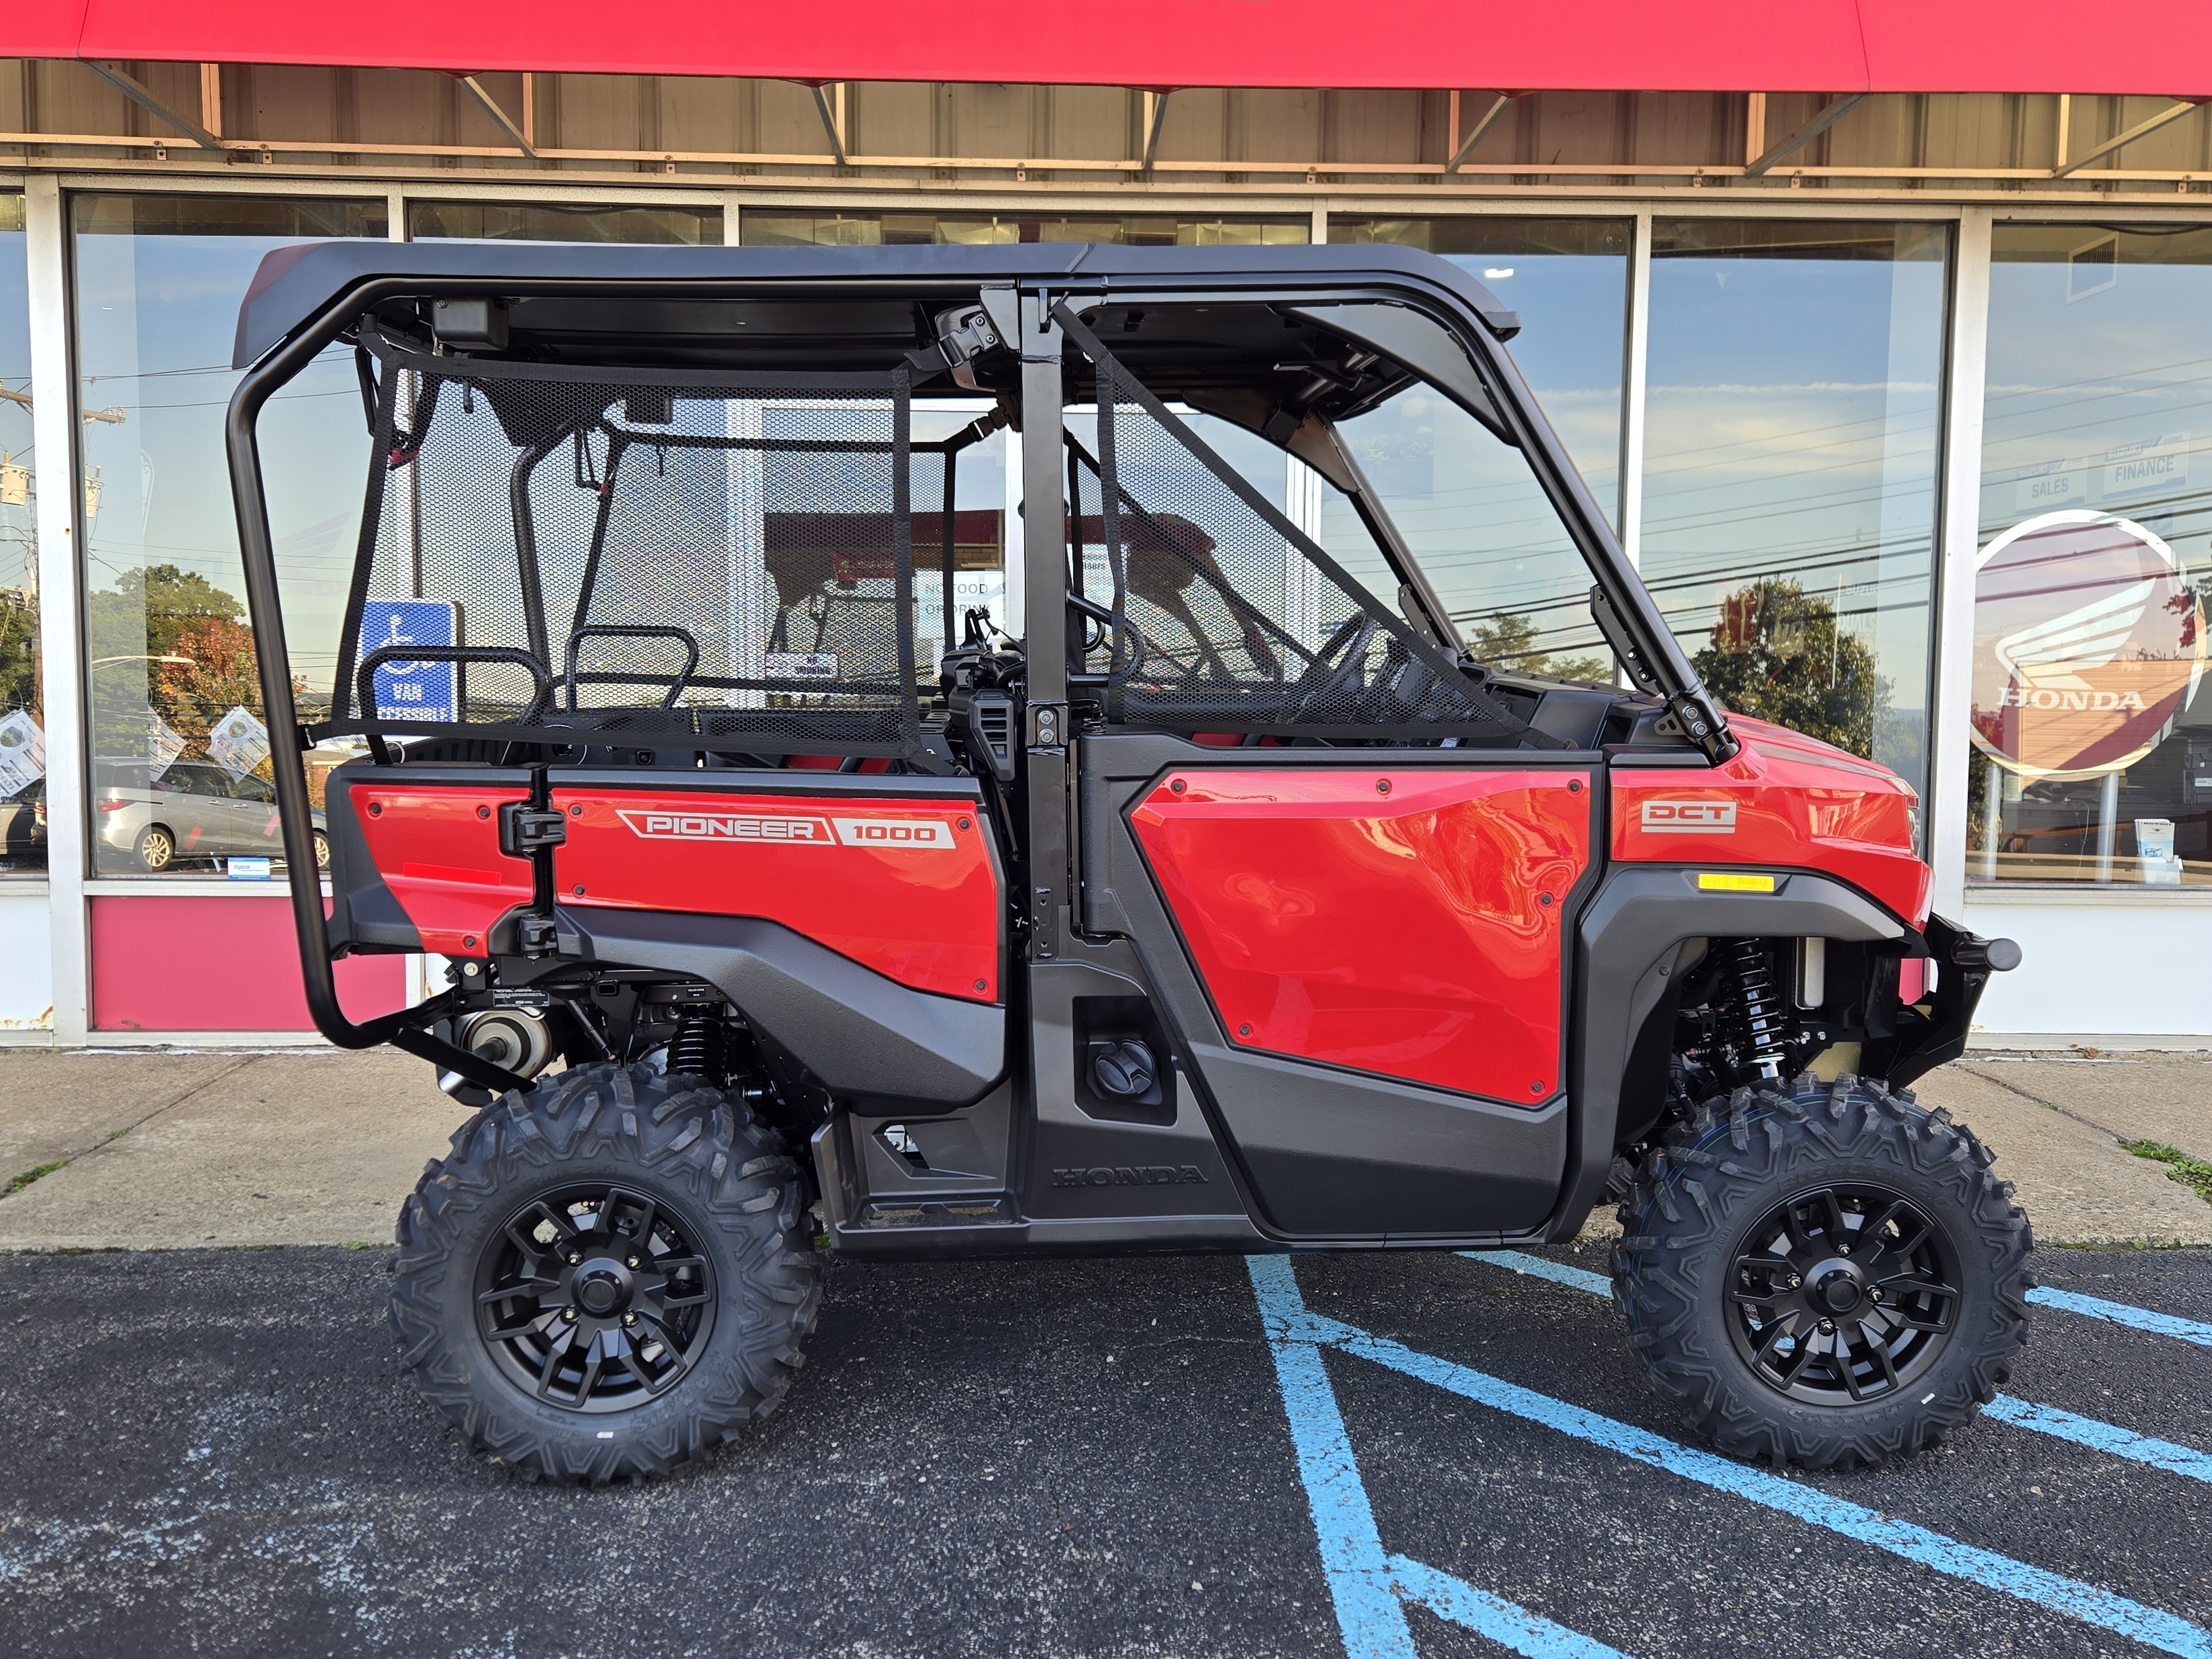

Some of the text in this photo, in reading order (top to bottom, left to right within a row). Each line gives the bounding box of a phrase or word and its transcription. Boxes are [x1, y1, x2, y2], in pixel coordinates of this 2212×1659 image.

[2107, 444, 2142, 460] SUZUKI
[2018, 465, 2048, 478] SUZUKI
[2115, 456, 2174, 482] FINANCE
[2032, 477, 2069, 498] SALES
[392, 682, 422, 701] VAN
[1997, 687, 2148, 711] HONDA
[377, 706, 447, 722] CCESSIBLE
[1648, 806, 1730, 820] DCT
[646, 816, 936, 842] PIONEER 1000
[1053, 1165, 1209, 1188] HONDA
